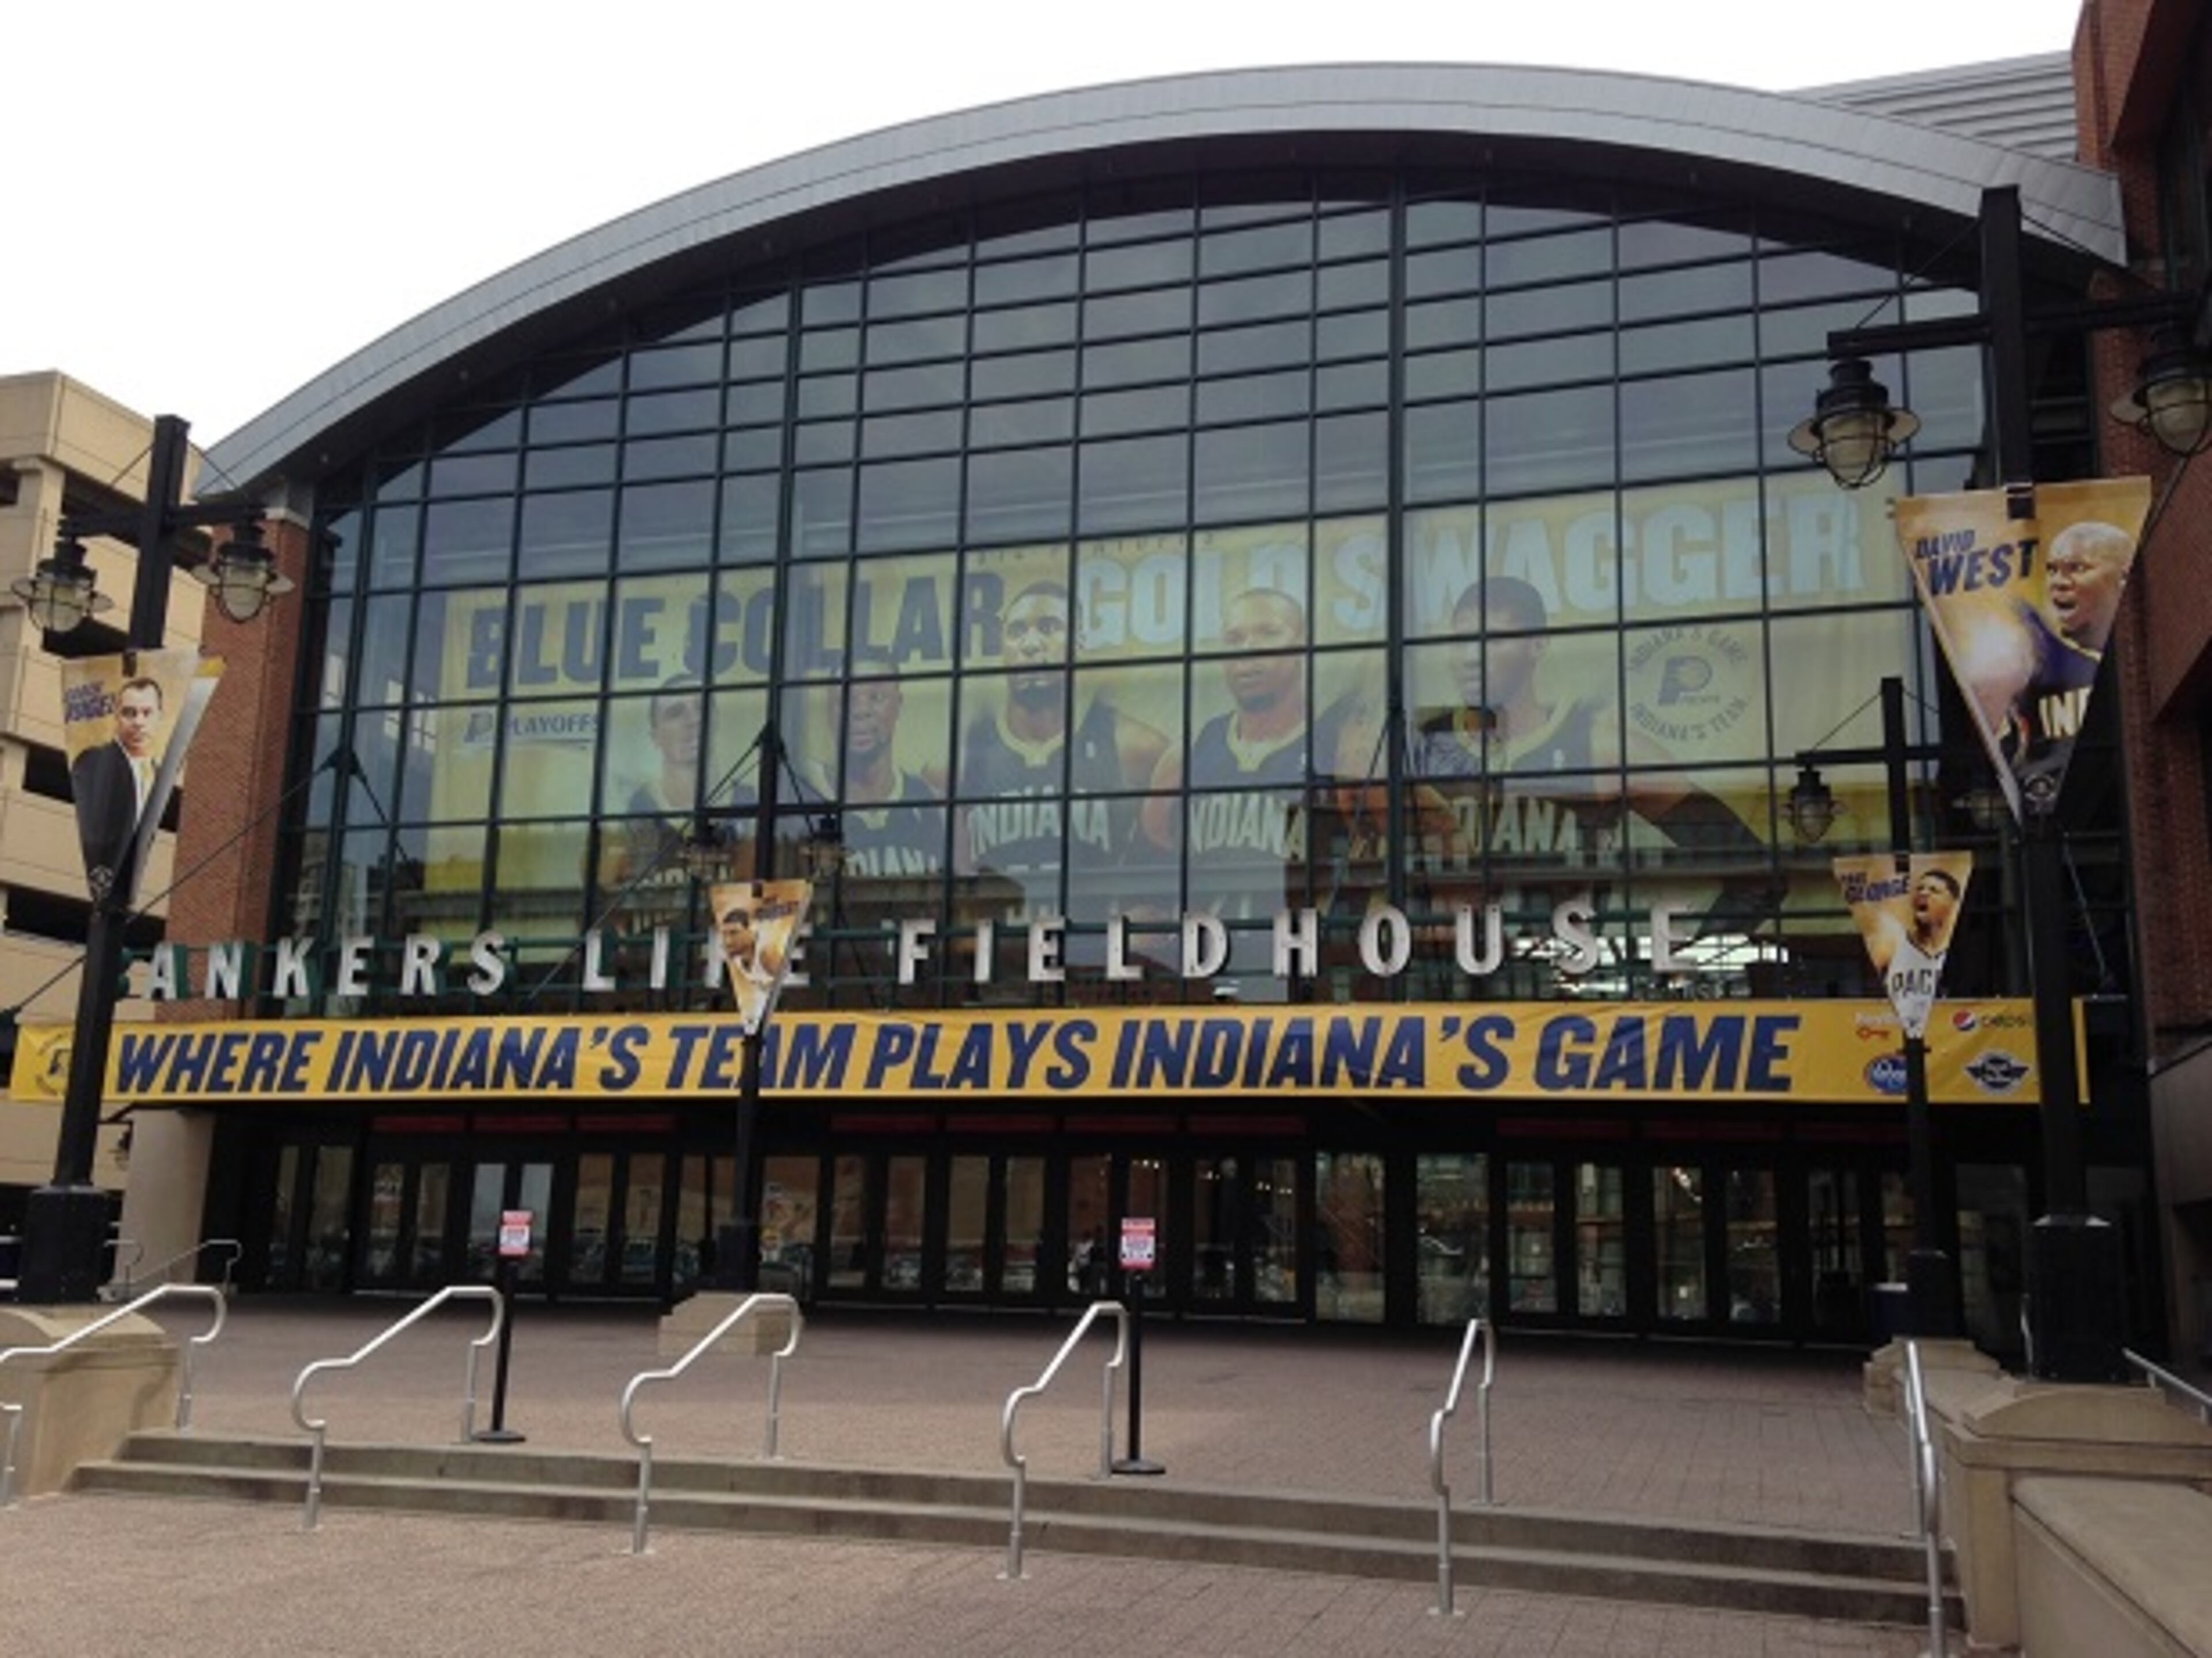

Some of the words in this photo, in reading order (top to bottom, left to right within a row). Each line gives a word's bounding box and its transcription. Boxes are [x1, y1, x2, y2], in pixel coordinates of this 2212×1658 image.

[1916, 529, 1975, 560] DAVID
[1929, 538, 2039, 597] WEST
[467, 597, 666, 689] BLUE
[684, 571, 1005, 675] COLLAR
[1333, 491, 1865, 631] SWAGGER
[1187, 790, 1308, 861] NDIANA
[144, 930, 507, 1001] ANKERS
[896, 896, 1699, 985] FIELDHOUSE
[1891, 969, 1940, 998] PAC
[117, 1030, 323, 1093] WHERE
[324, 1024, 649, 1092] INDIANA'S
[665, 1023, 858, 1091] TEAM
[863, 1019, 1098, 1090] PLAYS
[1108, 1015, 1516, 1091] INDIANA'S
[1533, 1015, 1802, 1092] GAME
